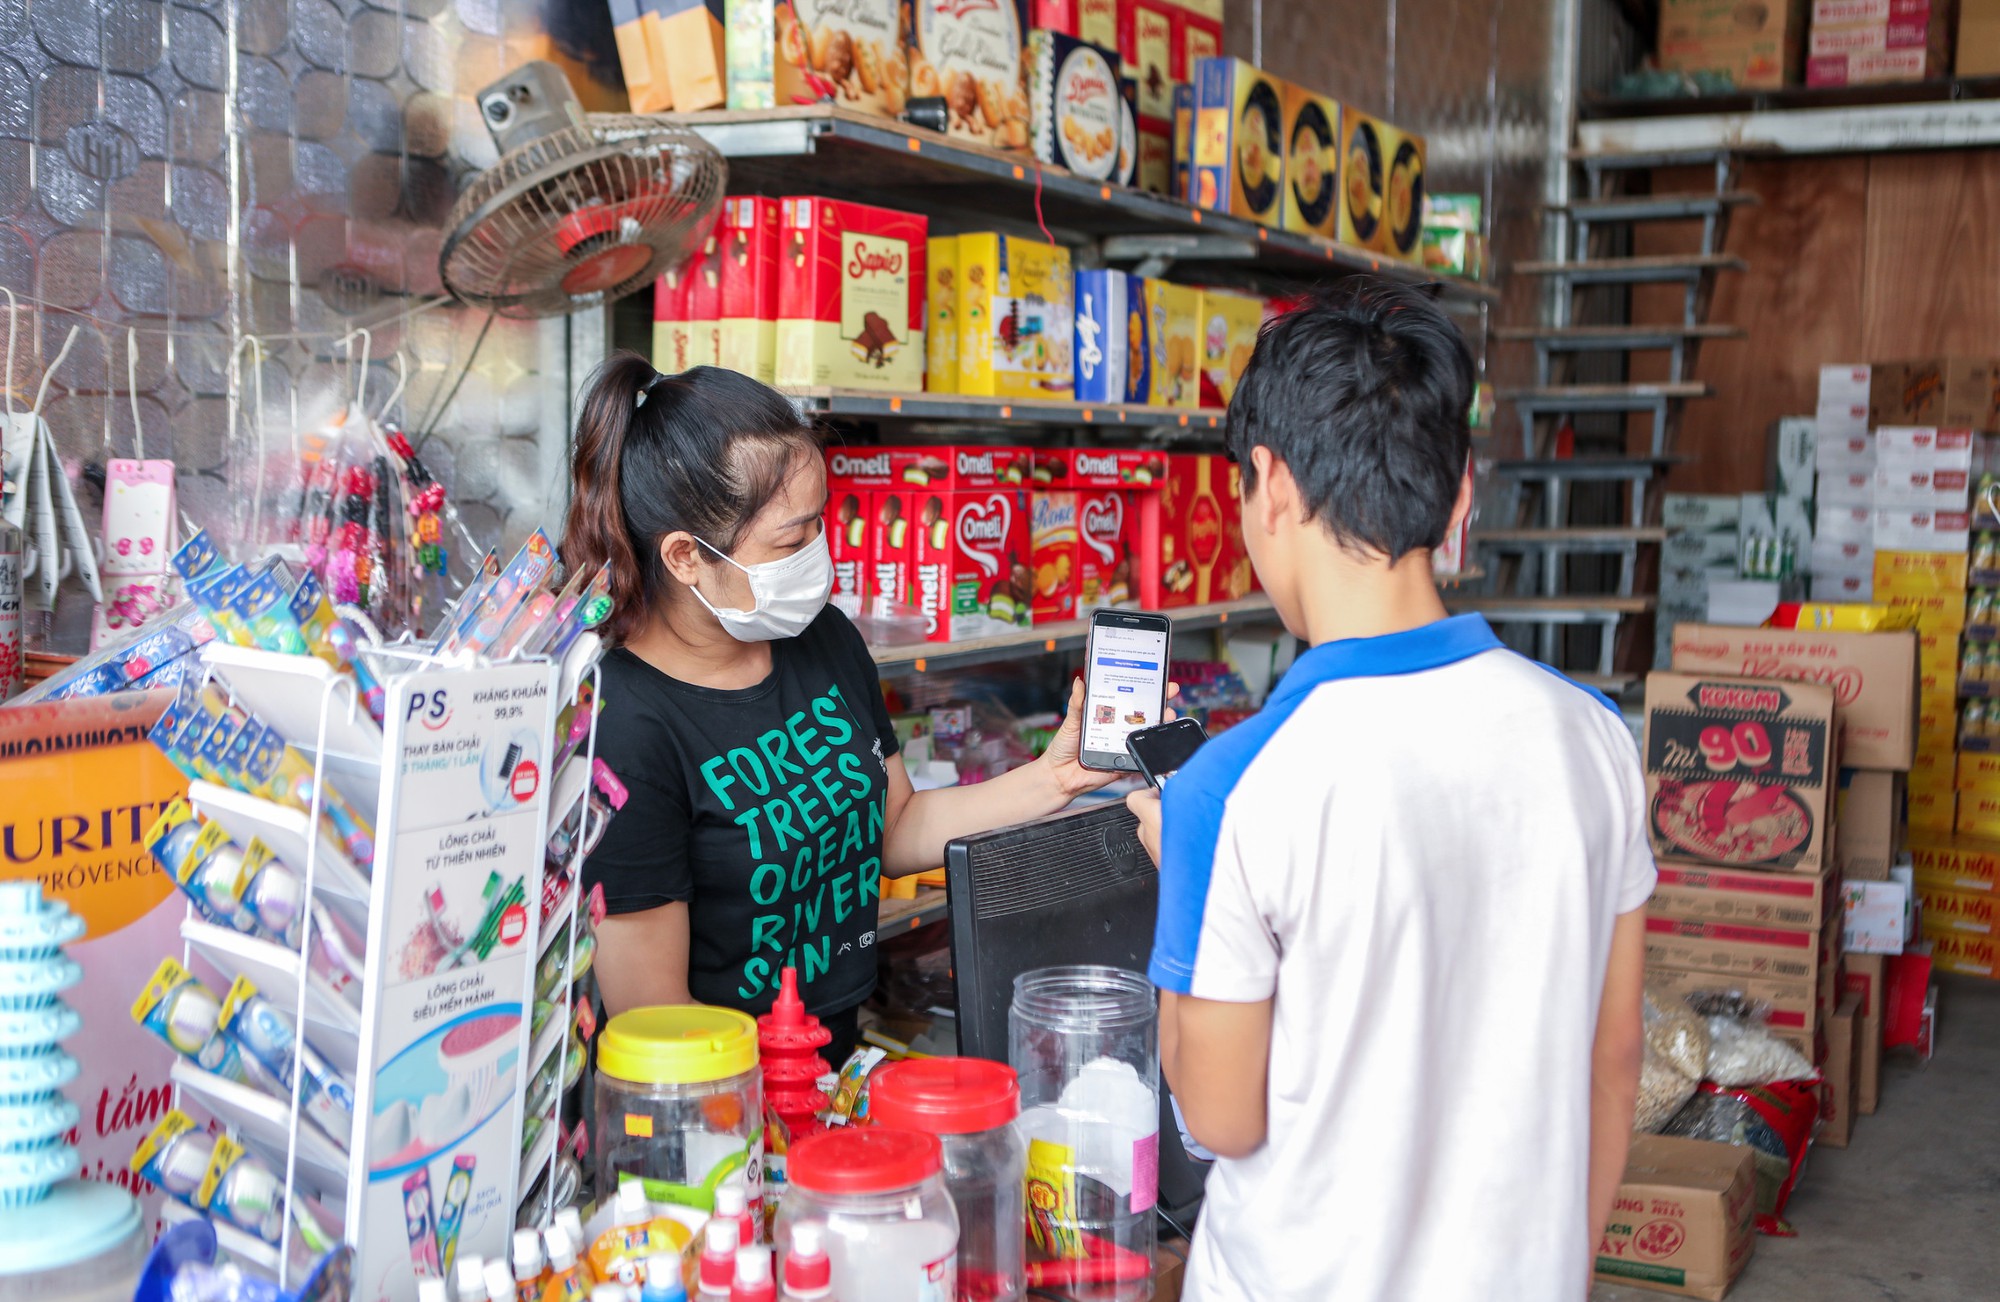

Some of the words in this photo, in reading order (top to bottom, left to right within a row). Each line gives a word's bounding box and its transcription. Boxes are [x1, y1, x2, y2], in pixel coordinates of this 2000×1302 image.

[831, 453, 892, 476] Omeli
[956, 451, 994, 475] Omeli
[1075, 453, 1119, 476] Omeli
[963, 514, 1002, 541] Omeli
[1088, 512, 1116, 534] Omeli
[1700, 685, 1780, 713] KOKOMI
[403, 745, 430, 759] THAY
[1699, 720, 1773, 772] 90
[734, 752, 873, 860] TREES
[439, 833, 469, 851] LÔNG
[471, 829, 496, 845] CHẢI
[749, 788, 887, 906] OCEAN
[443, 849, 473, 866] THIÊN
[475, 845, 507, 862] NHIÊN
[752, 857, 882, 953] RIVER
[427, 983, 457, 1001] LÔNG
[459, 970, 485, 990] CHẢI
[413, 1005, 437, 1022] SIÊU
[96, 1072, 171, 1138] tắm
